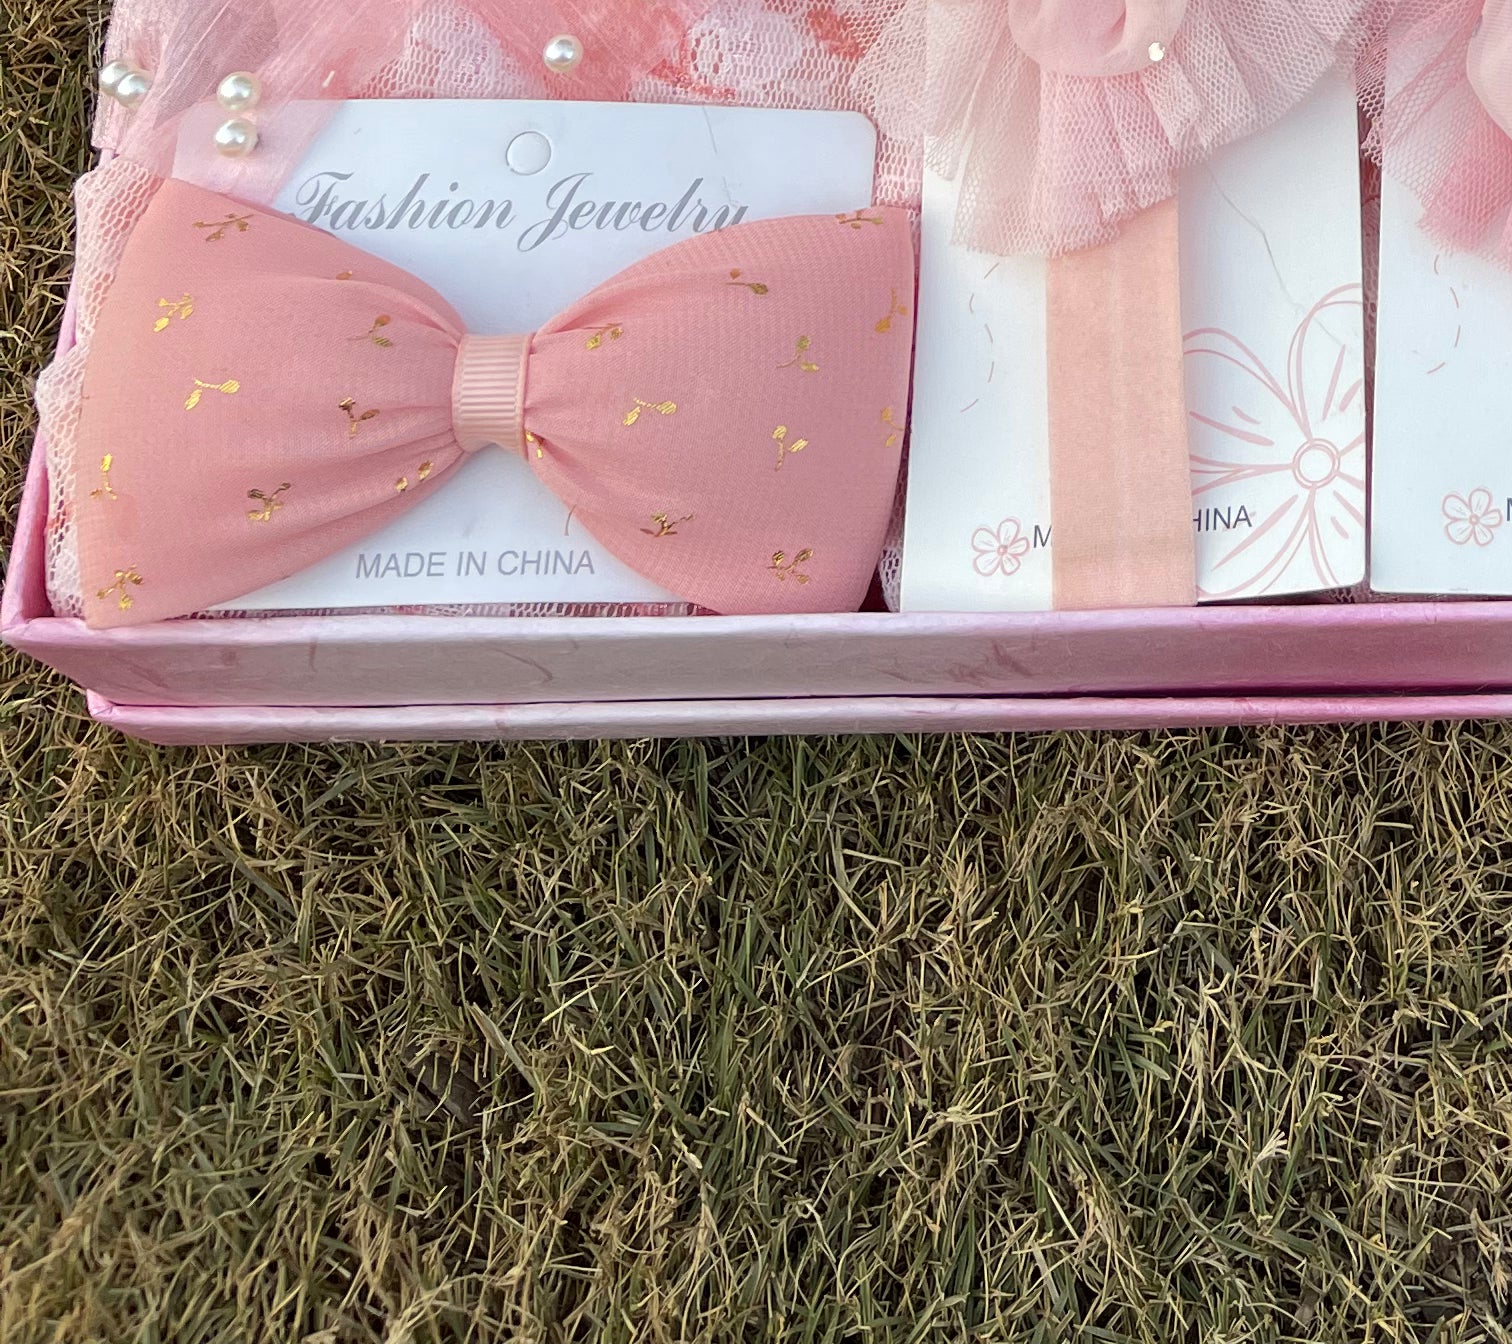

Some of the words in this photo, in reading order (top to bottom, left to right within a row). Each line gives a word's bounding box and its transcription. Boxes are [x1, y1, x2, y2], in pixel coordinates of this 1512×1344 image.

[296, 171, 518, 231] Fashion
[517, 172, 749, 253] Jewelry
[1193, 505, 1253, 532] HINA
[355, 551, 447, 579] MADE
[456, 551, 487, 576] IN
[497, 550, 595, 576] CHINA
